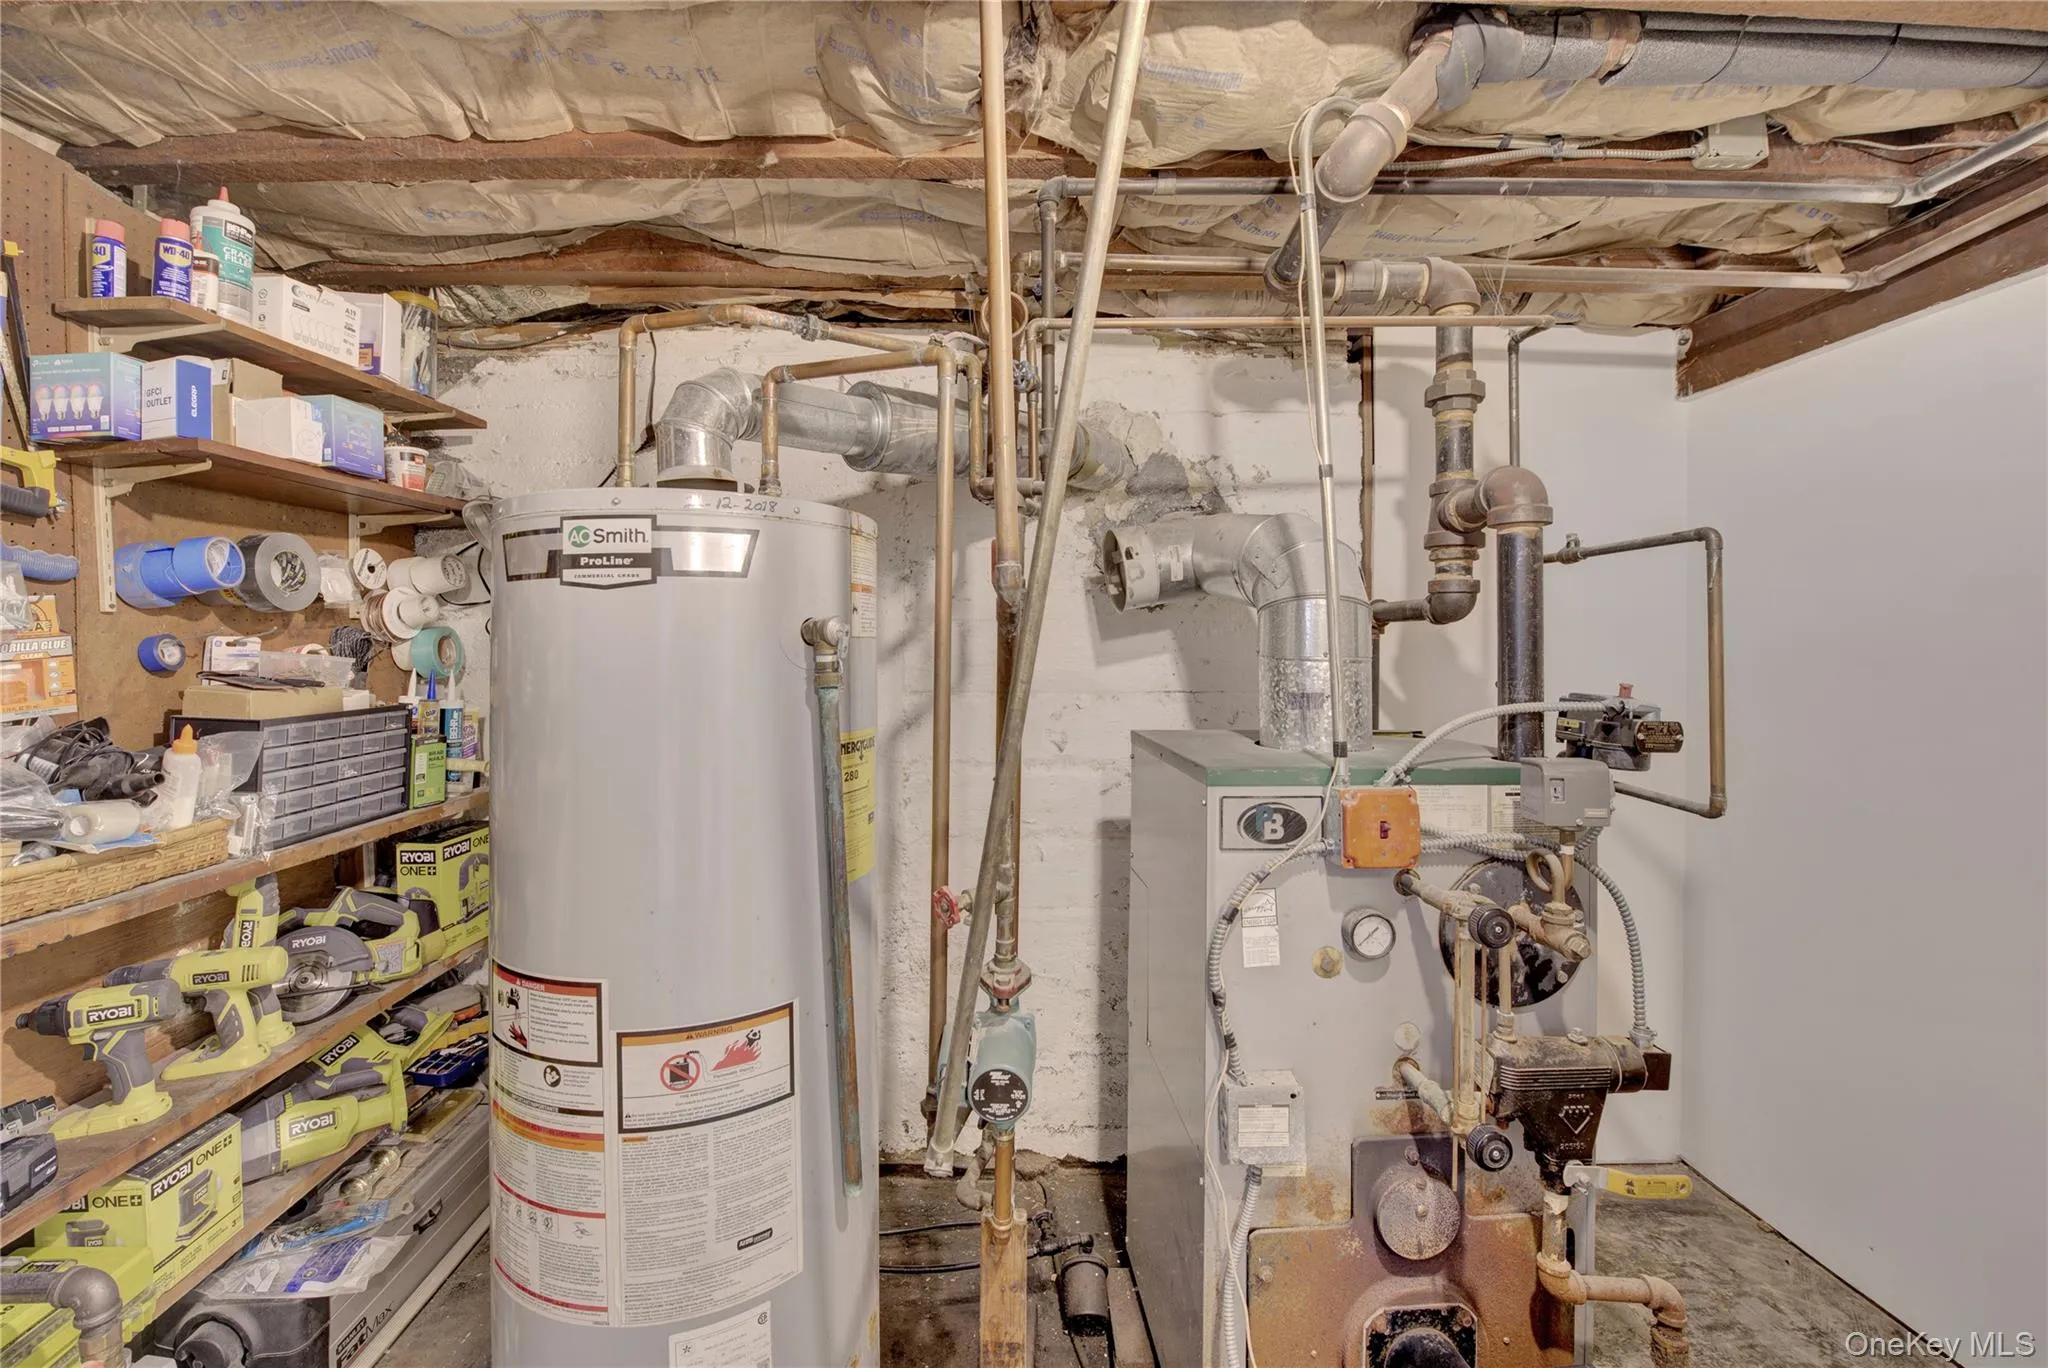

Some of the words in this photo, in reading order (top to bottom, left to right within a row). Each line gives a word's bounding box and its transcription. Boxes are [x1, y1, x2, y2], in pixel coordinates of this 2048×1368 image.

[162, 245, 190, 260] WD-40
[146, 397, 172, 408] OUTLET
[593, 527, 646, 544] Smith
[580, 555, 630, 566] ProLine
[41, 639, 66, 650] GLUE
[841, 736, 876, 755] NERGYGUIDE
[844, 770, 859, 782] 280
[401, 852, 434, 863] RYOBI
[443, 840, 470, 860] RYOBI
[241, 920, 253, 948] RYOB
[291, 934, 327, 949] RYOBI
[193, 973, 229, 985] RYOBI
[87, 1006, 133, 1023] RYOBI
[694, 1026, 734, 1039] WARNING
[320, 1035, 358, 1066] RYOBI
[290, 1114, 335, 1136] RYOBI
[151, 1164, 193, 1197] RYOBI
